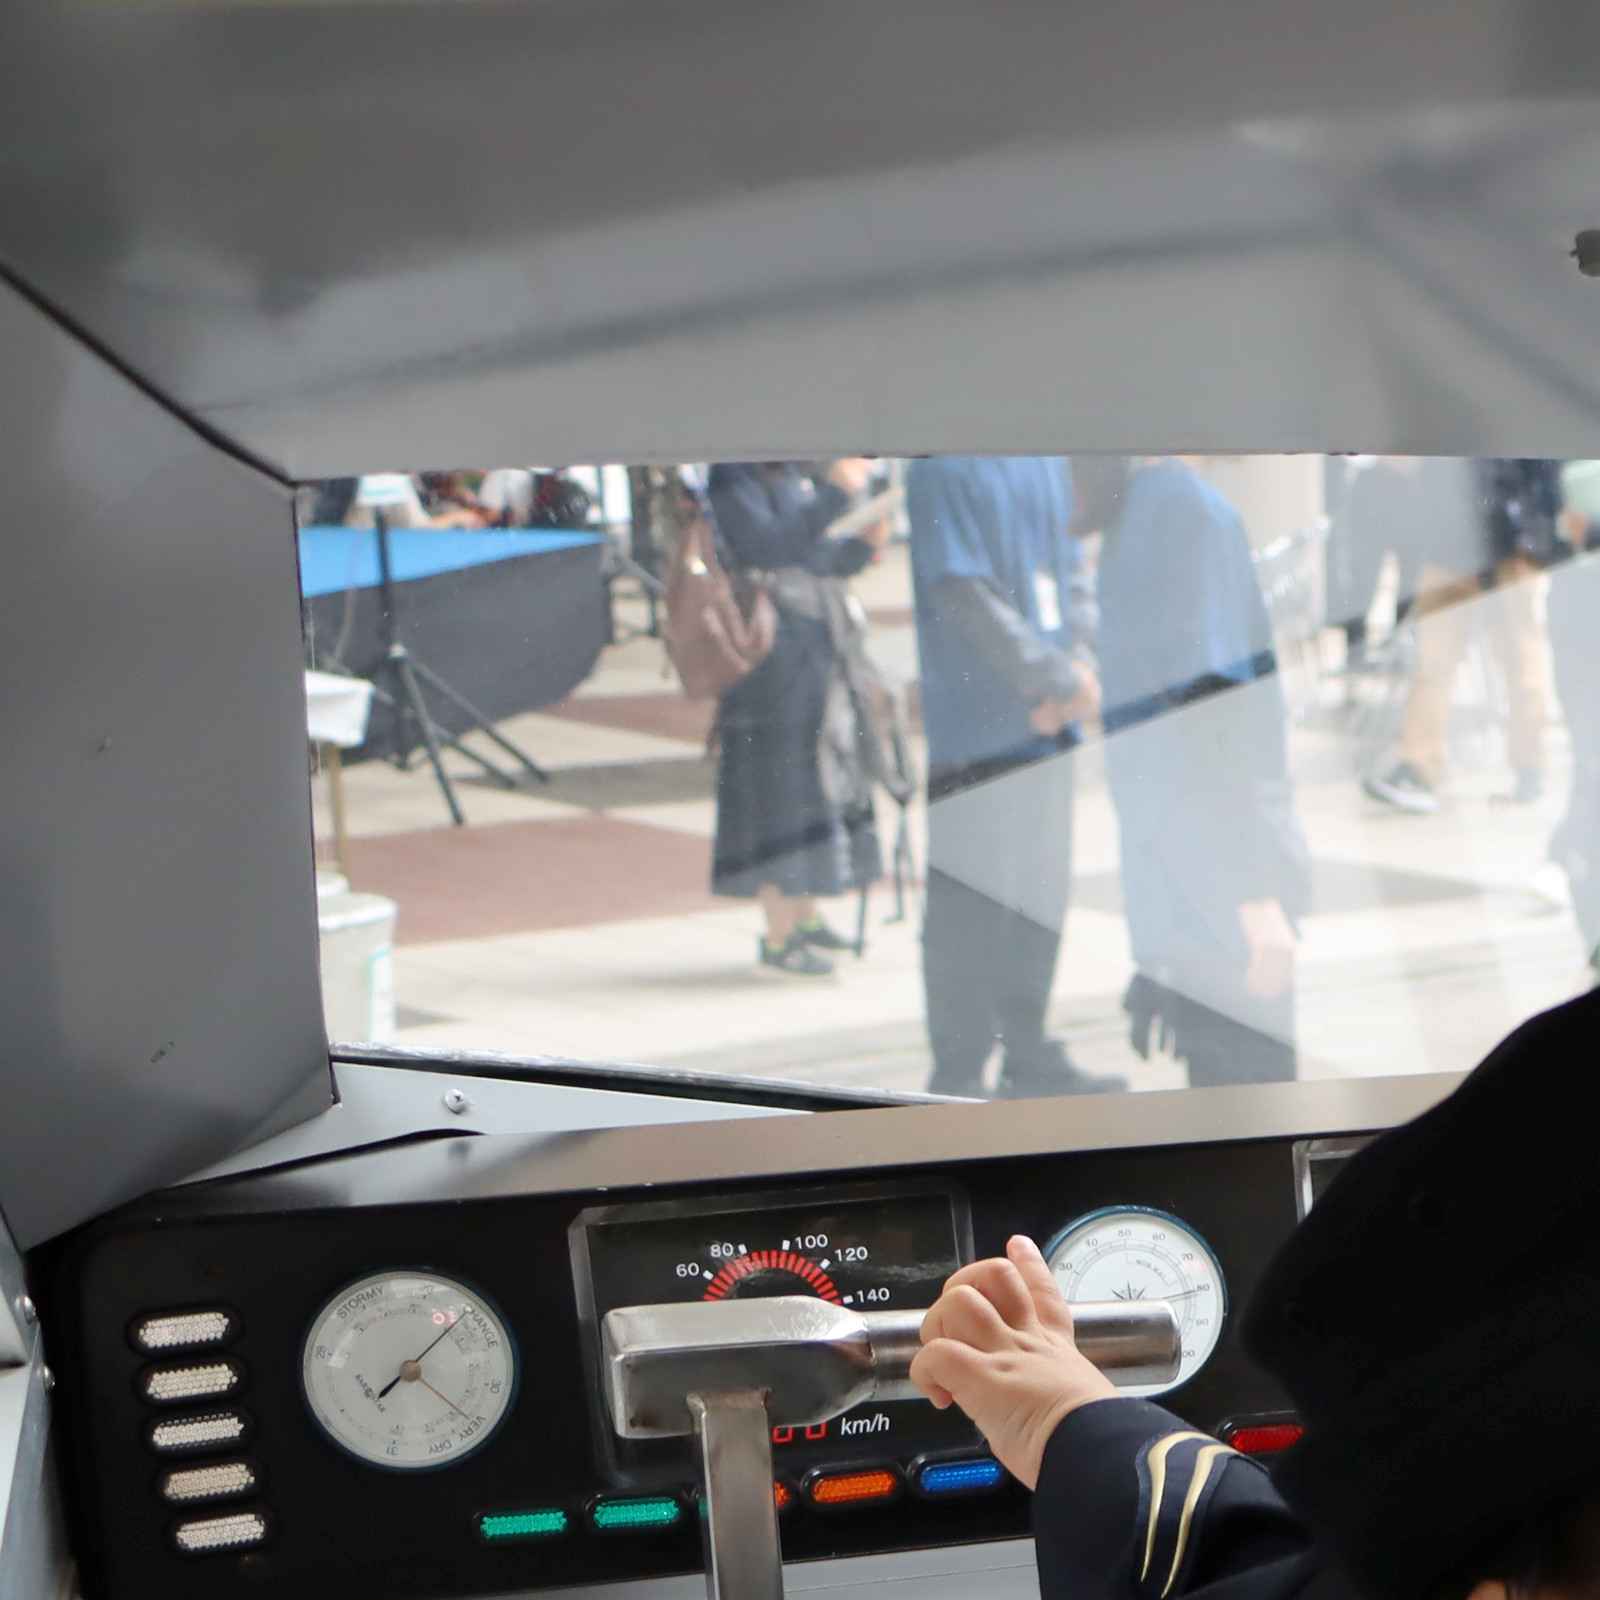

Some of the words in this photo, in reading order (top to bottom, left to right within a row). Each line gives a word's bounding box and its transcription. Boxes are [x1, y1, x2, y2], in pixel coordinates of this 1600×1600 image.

[795, 1234, 829, 1249] 100
[710, 1242, 734, 1258] 80
[835, 1246, 868, 1262] 120
[676, 1262, 700, 1277] 60
[338, 1286, 385, 1319] STORMY
[856, 1287, 890, 1303] 140
[462, 1303, 498, 1348] CHANGE
[458, 1415, 487, 1441] VERY
[840, 1413, 890, 1435] km/h
[428, 1439, 452, 1456] DRY
